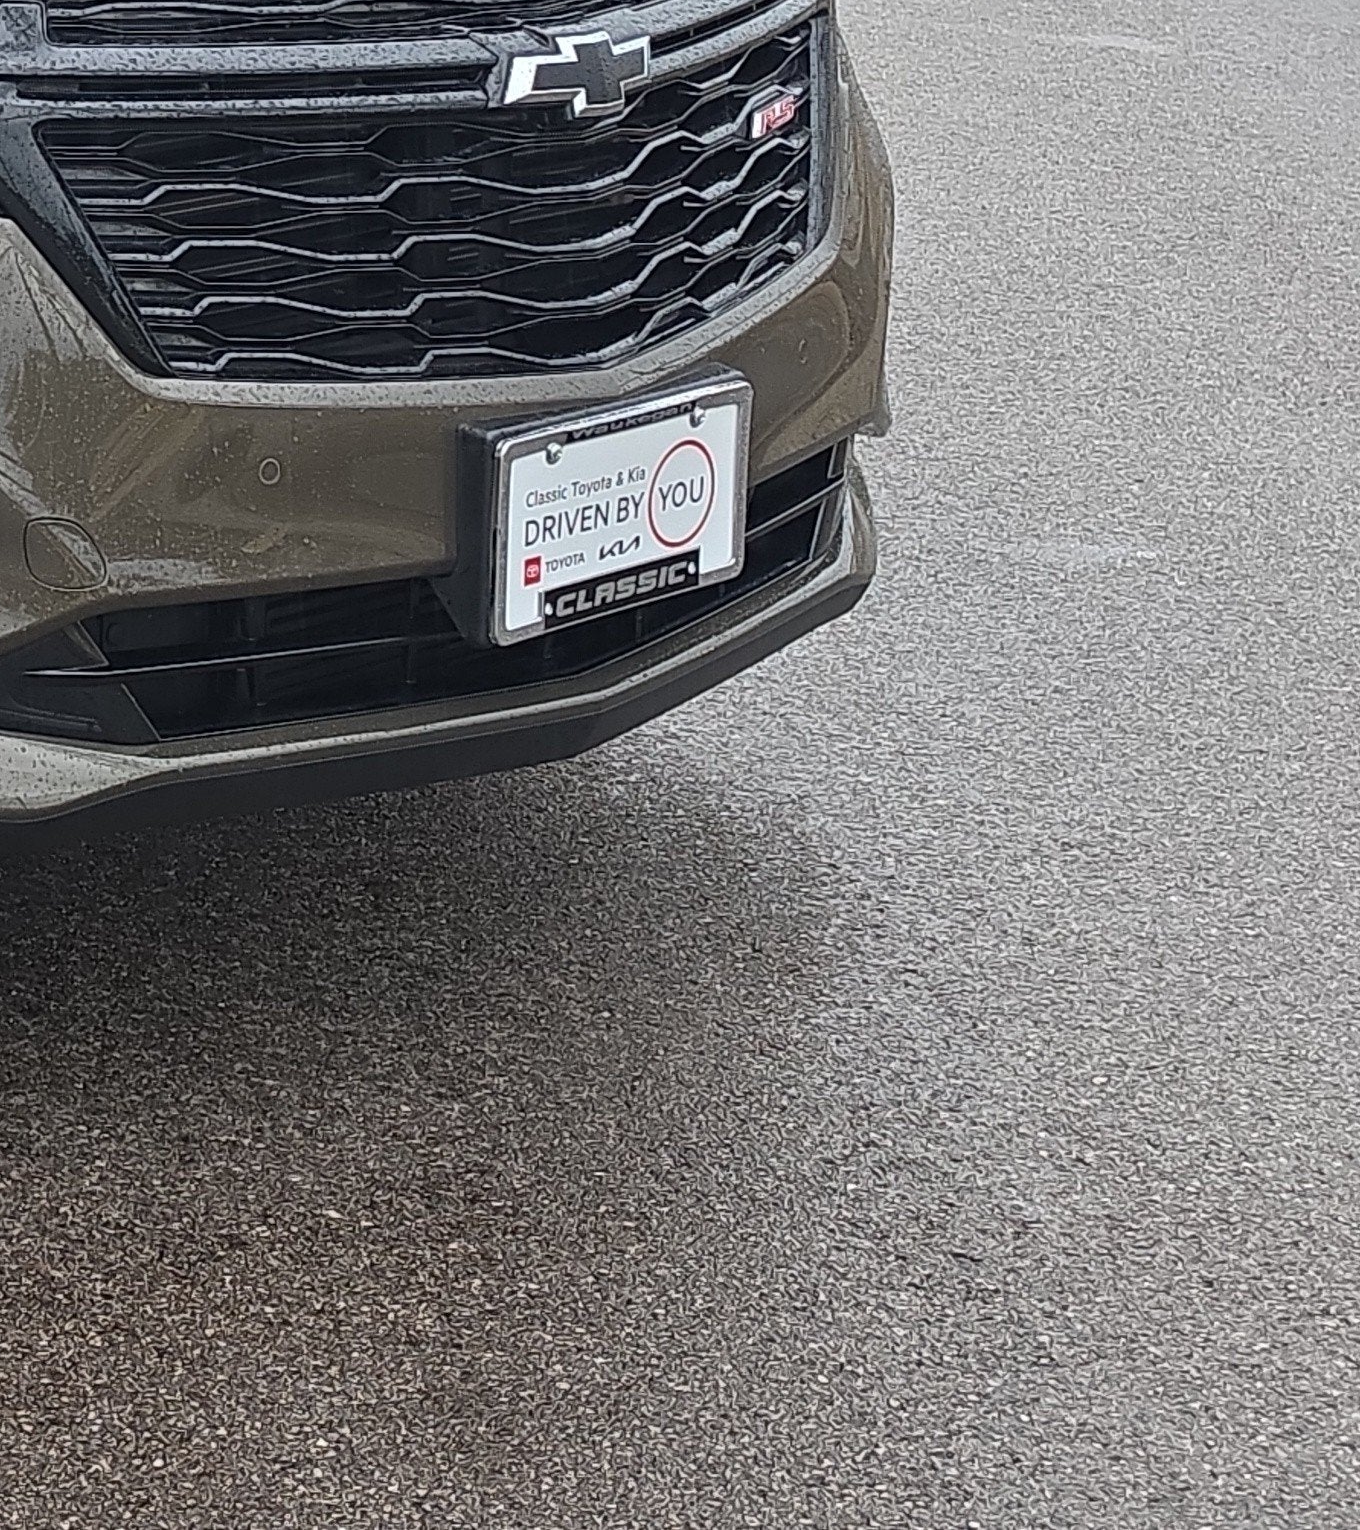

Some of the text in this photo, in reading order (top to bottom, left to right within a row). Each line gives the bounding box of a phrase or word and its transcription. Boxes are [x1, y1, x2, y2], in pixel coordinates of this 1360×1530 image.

[751, 94, 795, 139] RS
[526, 465, 646, 508] Classic Toyota & Kia
[524, 475, 705, 548] DRIVEN BY YOU
[545, 552, 586, 574] TOYOTA
[555, 560, 688, 618] CLASSIC
